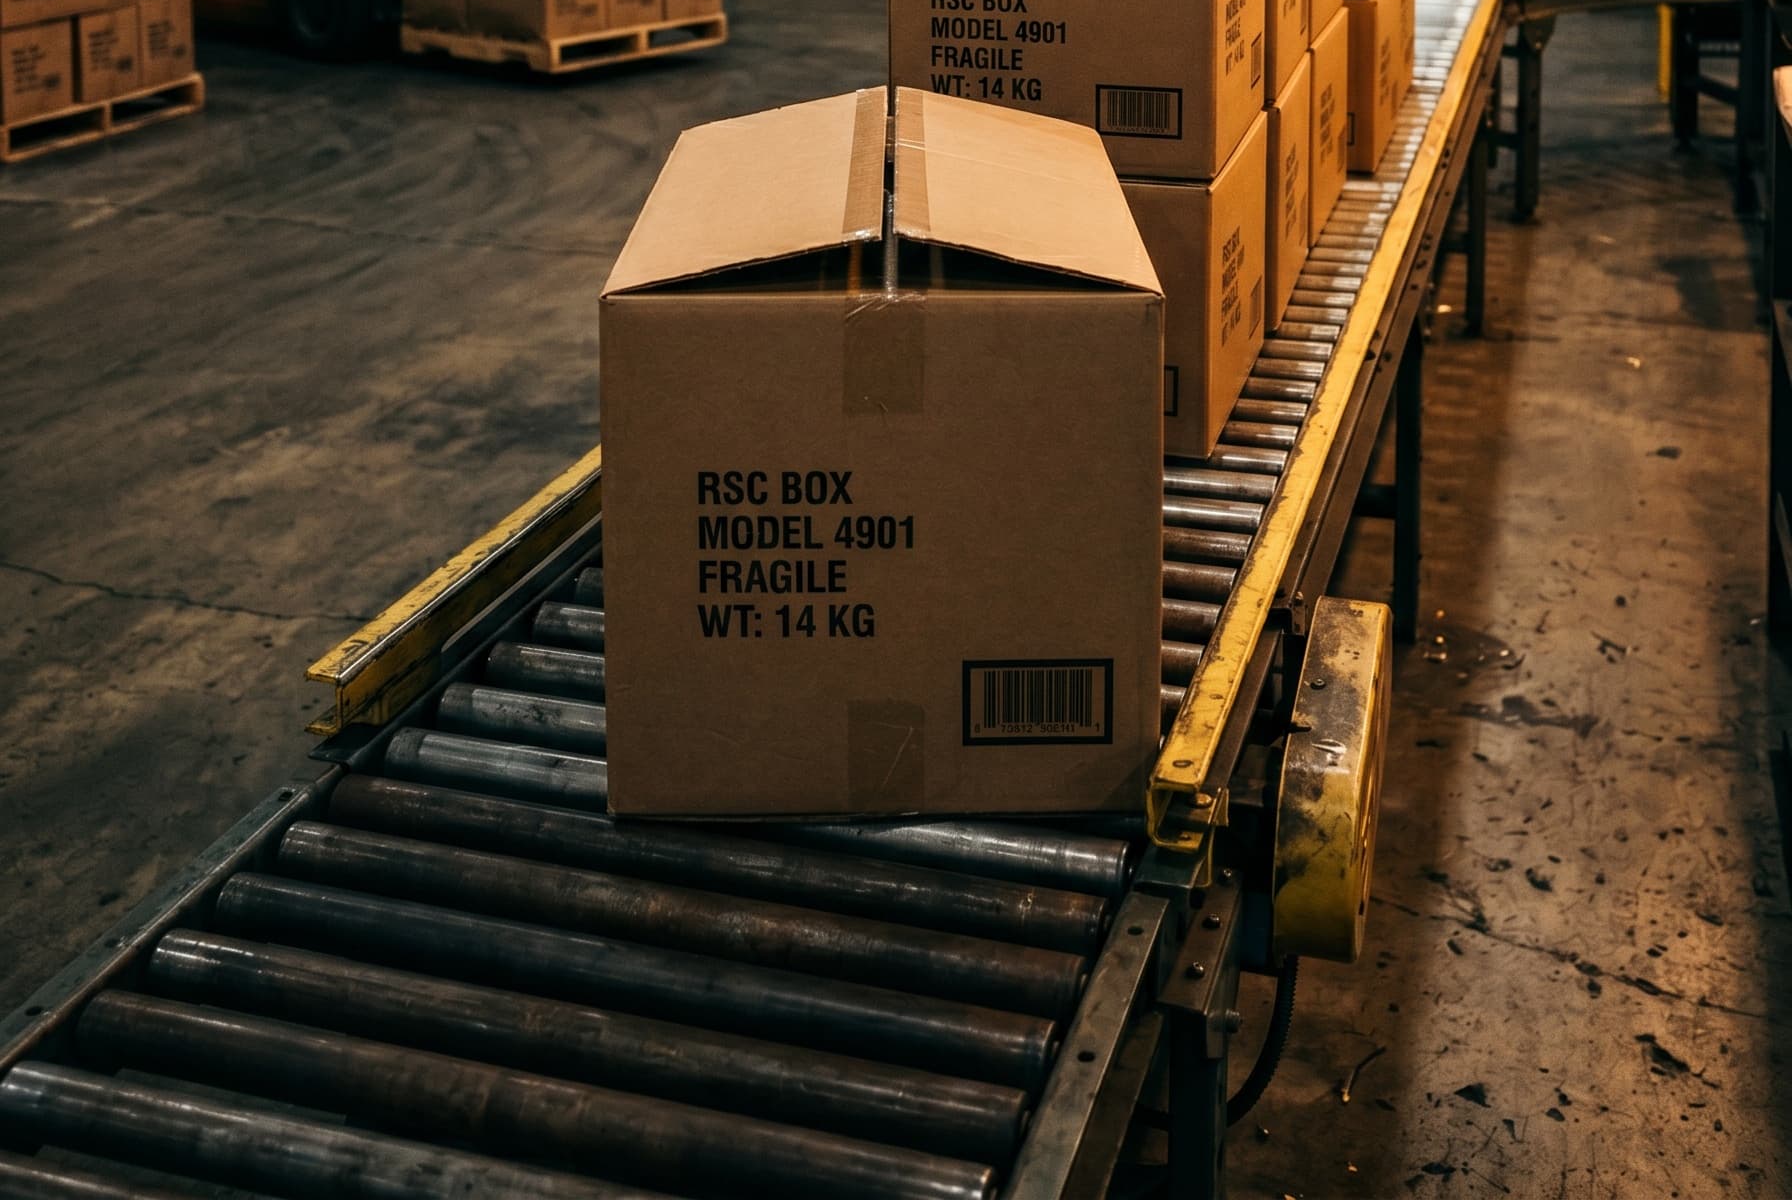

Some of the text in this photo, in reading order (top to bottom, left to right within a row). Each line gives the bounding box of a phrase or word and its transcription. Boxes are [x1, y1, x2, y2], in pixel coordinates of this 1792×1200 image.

[931, 16, 1067, 44] MODEL 4901
[931, 45, 1023, 71] FRAGILE
[931, 73, 1042, 101] WT: 14 KG
[697, 471, 853, 505] RSC BOX
[698, 515, 914, 550] MODEL 4901
[698, 559, 847, 593] FRAGILE
[697, 603, 875, 638] WT: 14 KG
